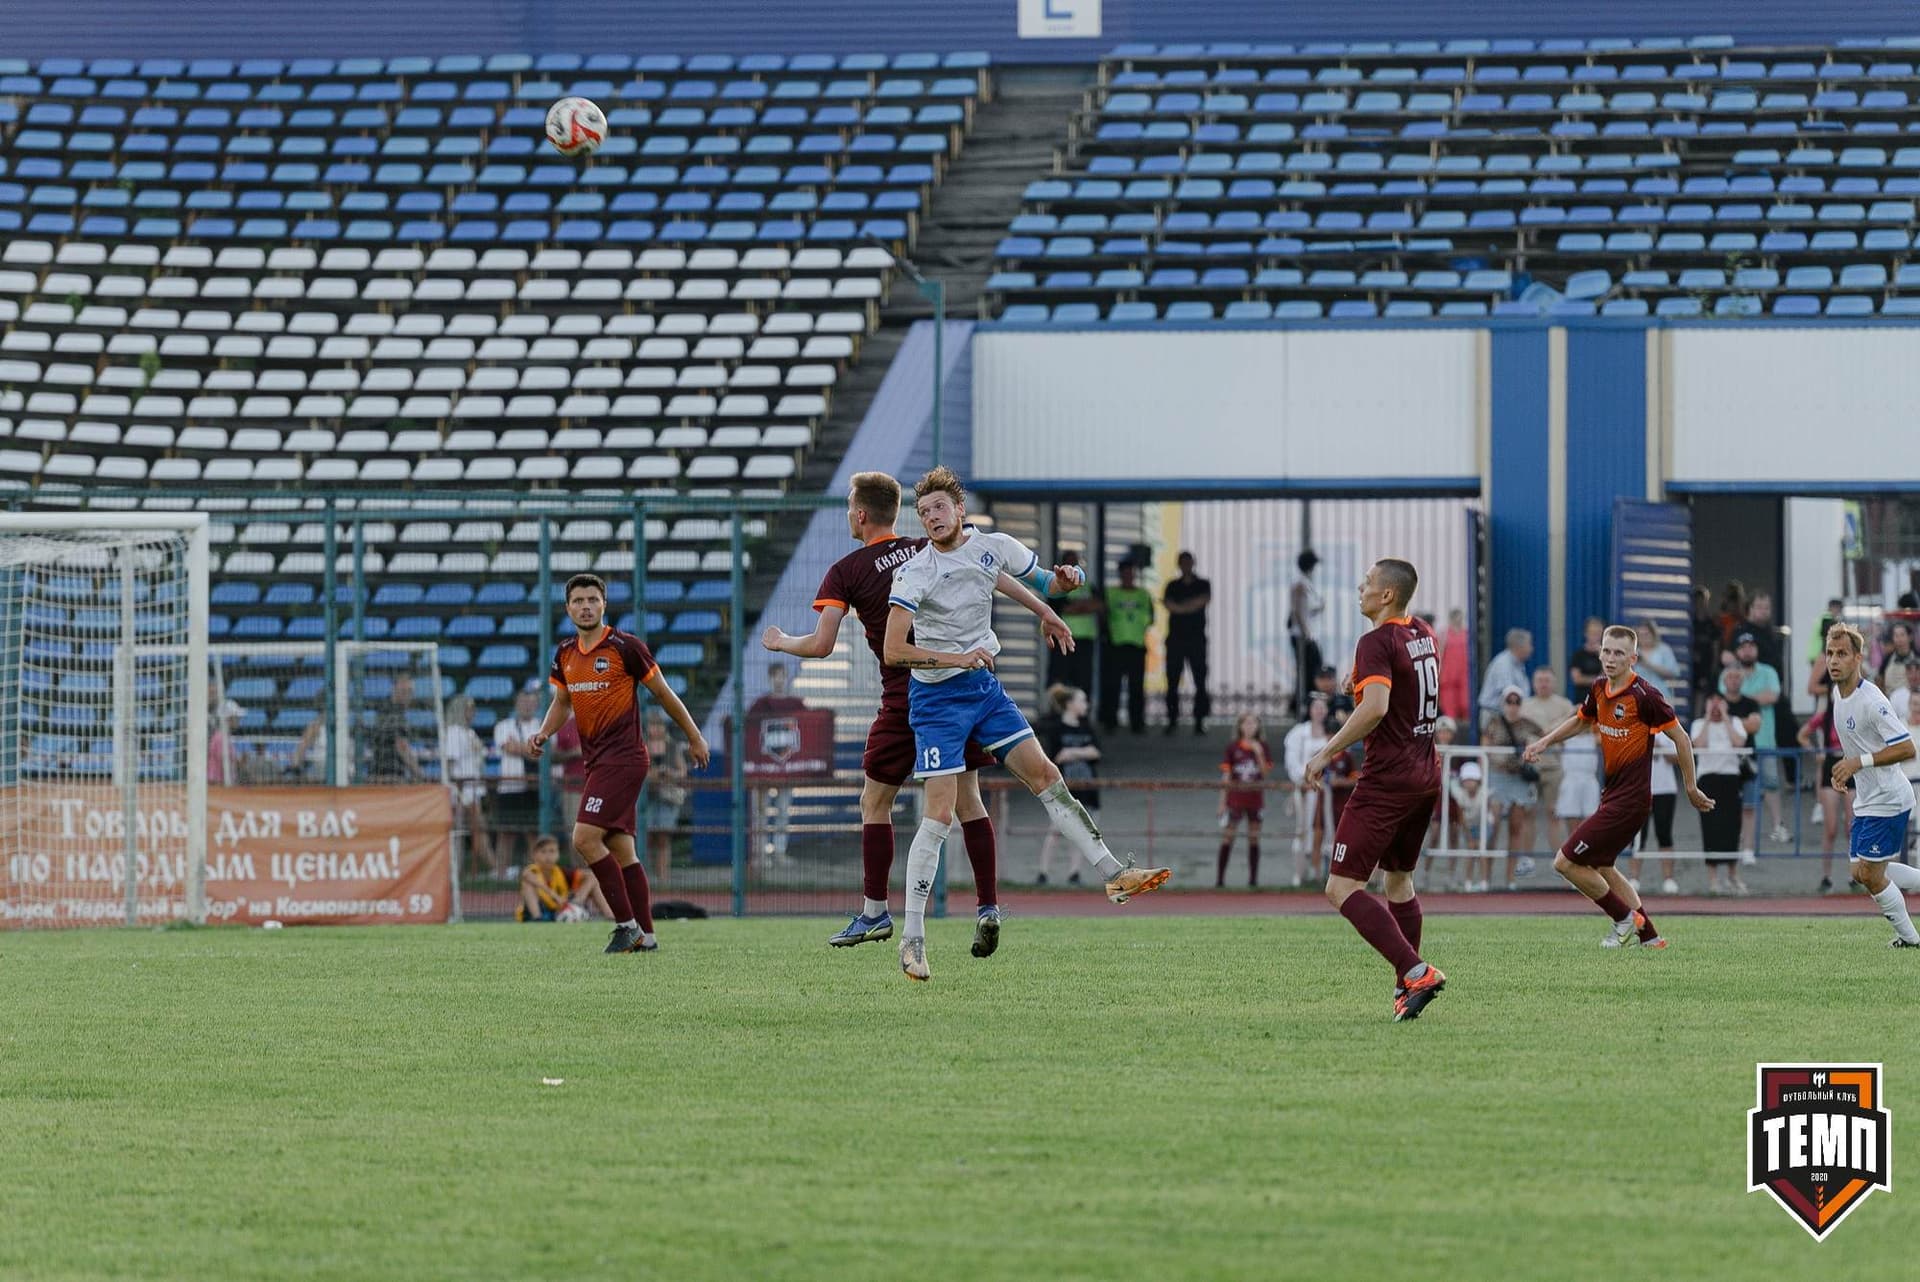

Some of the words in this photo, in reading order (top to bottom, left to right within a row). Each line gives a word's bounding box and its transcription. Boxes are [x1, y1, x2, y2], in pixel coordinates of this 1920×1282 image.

[1413, 656, 1438, 721] 19
[923, 746, 942, 769] 13
[585, 796, 603, 814] 22
[214, 810, 282, 848] для
[298, 810, 358, 838] вас
[1333, 842, 1347, 863] 19
[1573, 839, 1590, 856] 17
[10, 853, 50, 883] по
[270, 835, 400, 890] ценам!
[248, 902, 272, 916] на
[408, 893, 433, 914] 59
